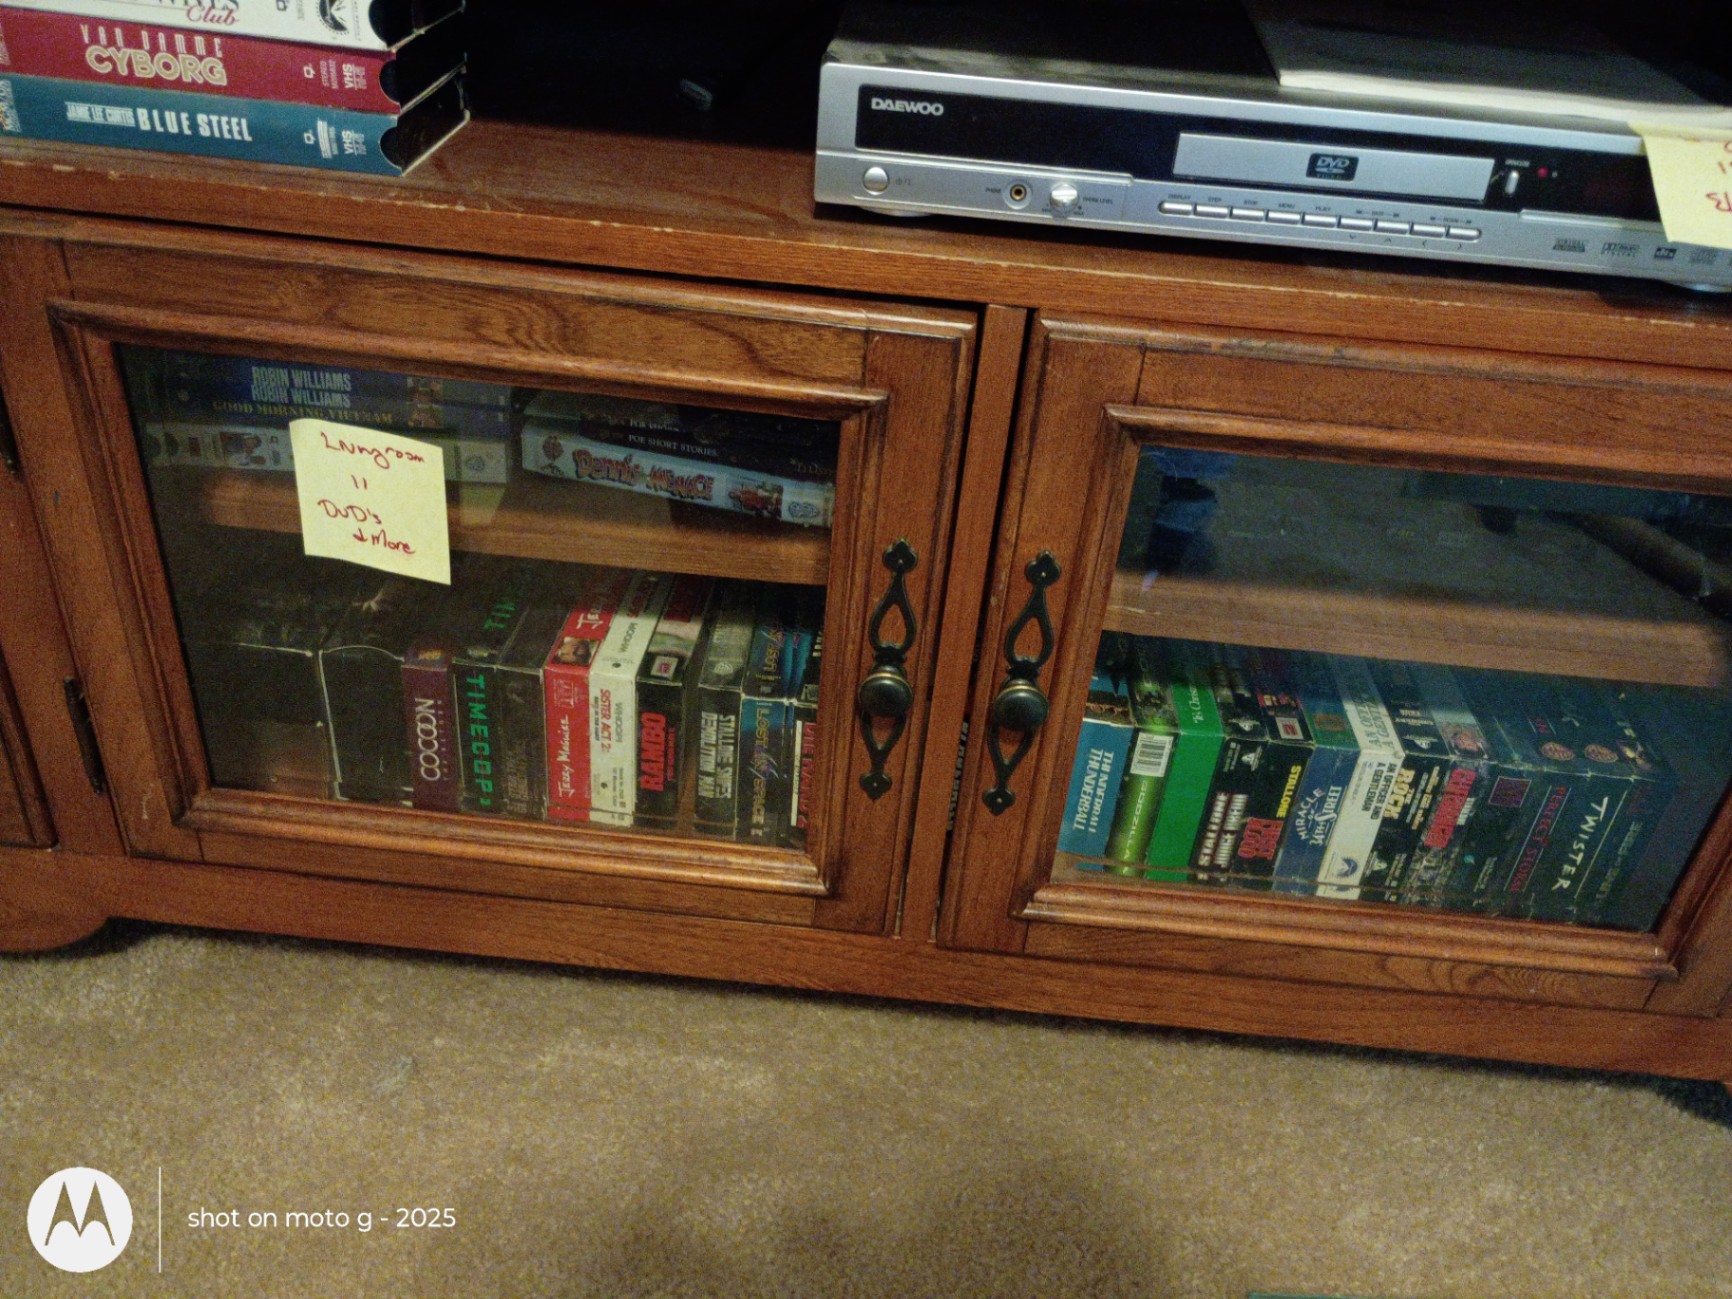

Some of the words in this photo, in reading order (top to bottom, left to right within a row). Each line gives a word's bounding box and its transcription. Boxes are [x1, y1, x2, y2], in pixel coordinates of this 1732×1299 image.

[187, 4, 239, 26] Club
[80, 23, 124, 48] VAN
[141, 30, 223, 58] DAMME
[85, 45, 228, 86] CYBORG
[342, 63, 354, 89] VHS
[136, 107, 192, 135] BLUE
[197, 113, 253, 142] STEEL
[871, 97, 944, 117] DAEWOO
[342, 130, 354, 154] VHS
[1316, 156, 1350, 169] DVD
[251, 366, 290, 388] ROBIN
[292, 368, 351, 392] WILLIAMS
[648, 436, 678, 451] SHORT
[371, 532, 416, 555] More
[601, 689, 612, 720] SISTER
[415, 698, 441, 781] COCOON
[466, 673, 493, 795] TIMECOP
[601, 722, 611, 742] ACT
[699, 711, 718, 772] DEMOLITION
[754, 707, 771, 748] LOST
[641, 712, 667, 791] RAMBO
[1387, 762, 1398, 773] AN
[1072, 747, 1104, 831] THUNDERBALL
[1276, 765, 1302, 818] STALLONE
[1362, 768, 1384, 812] GENTLEMAN
[1376, 774, 1396, 804] OFFICER
[1384, 768, 1415, 820] ROCK
[1123, 779, 1148, 860] GODZILLA
[1294, 787, 1325, 841] MIRACLE
[1371, 805, 1383, 820] AND
[1551, 795, 1609, 891] TWISTER
